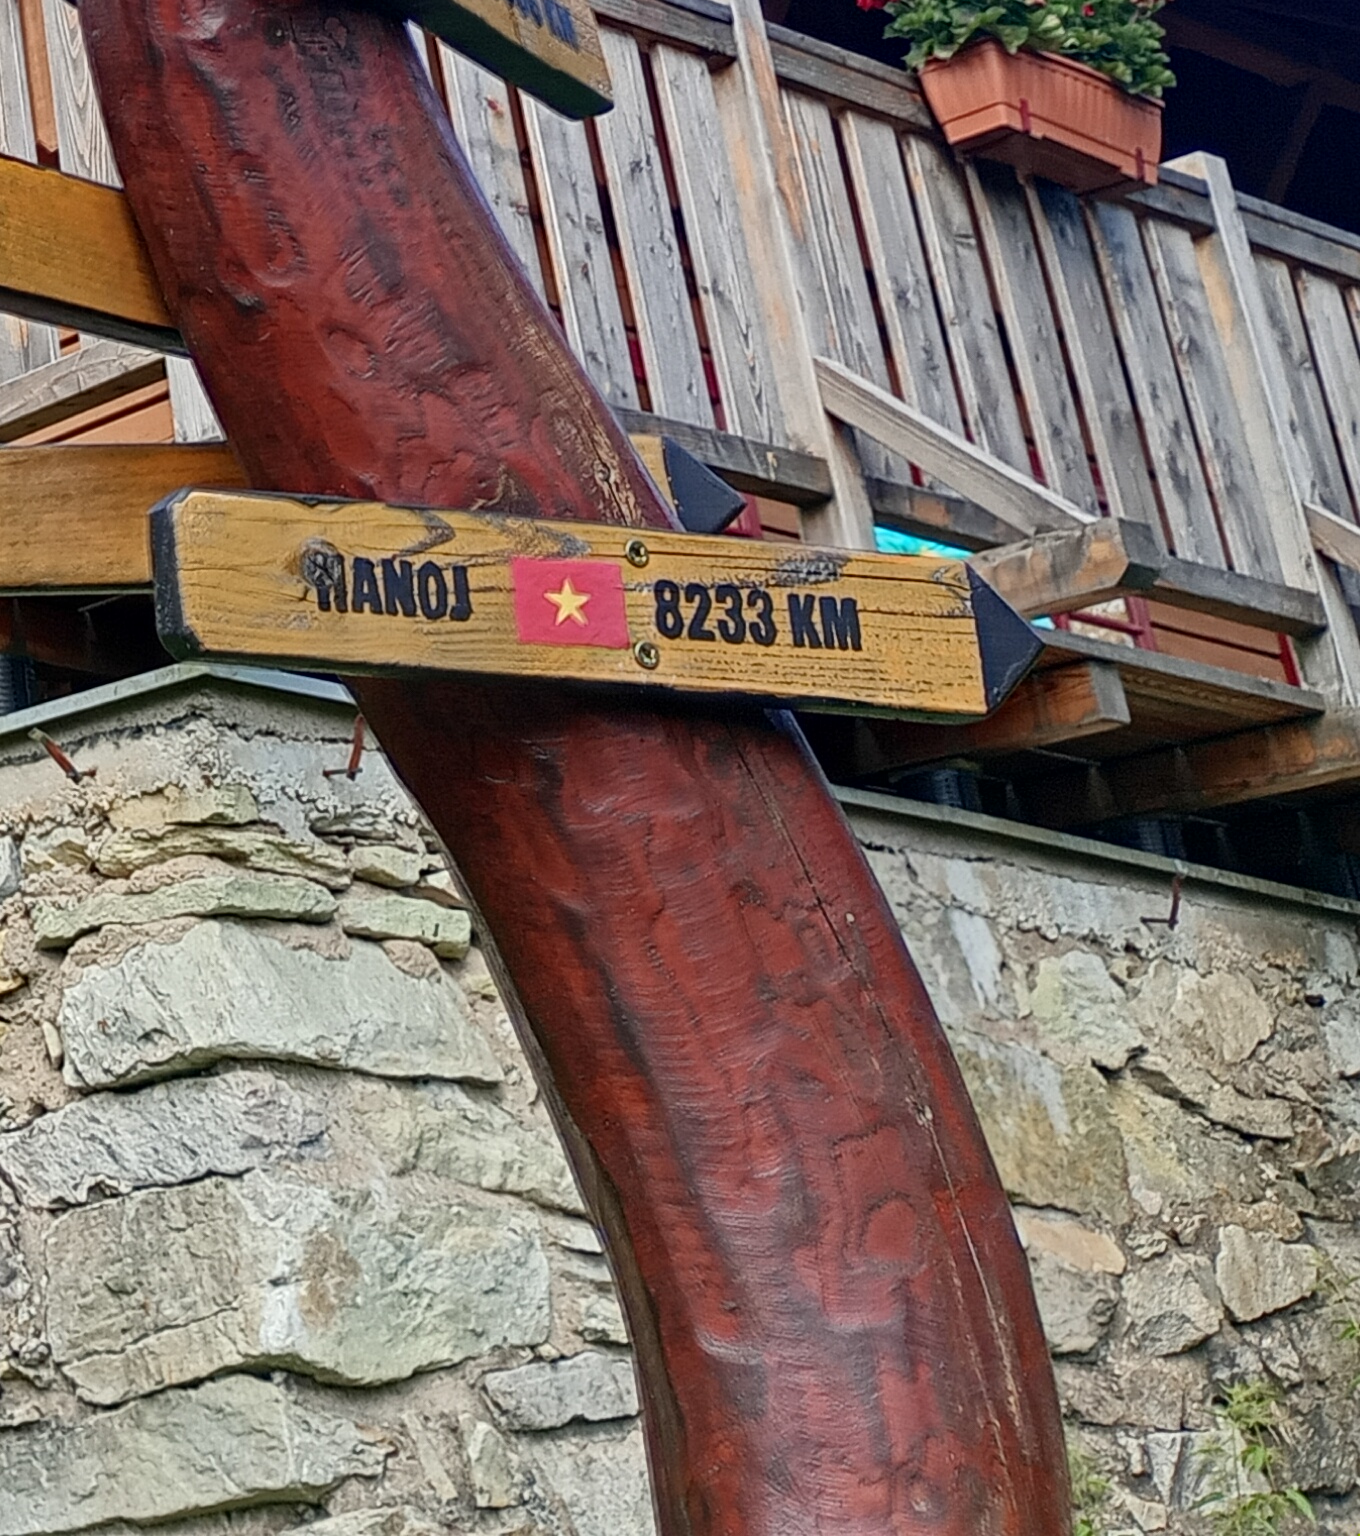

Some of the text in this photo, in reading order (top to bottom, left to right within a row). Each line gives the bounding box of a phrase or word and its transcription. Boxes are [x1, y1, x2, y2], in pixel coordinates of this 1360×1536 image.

[314, 553, 863, 651] HANOJ 8233 KM
